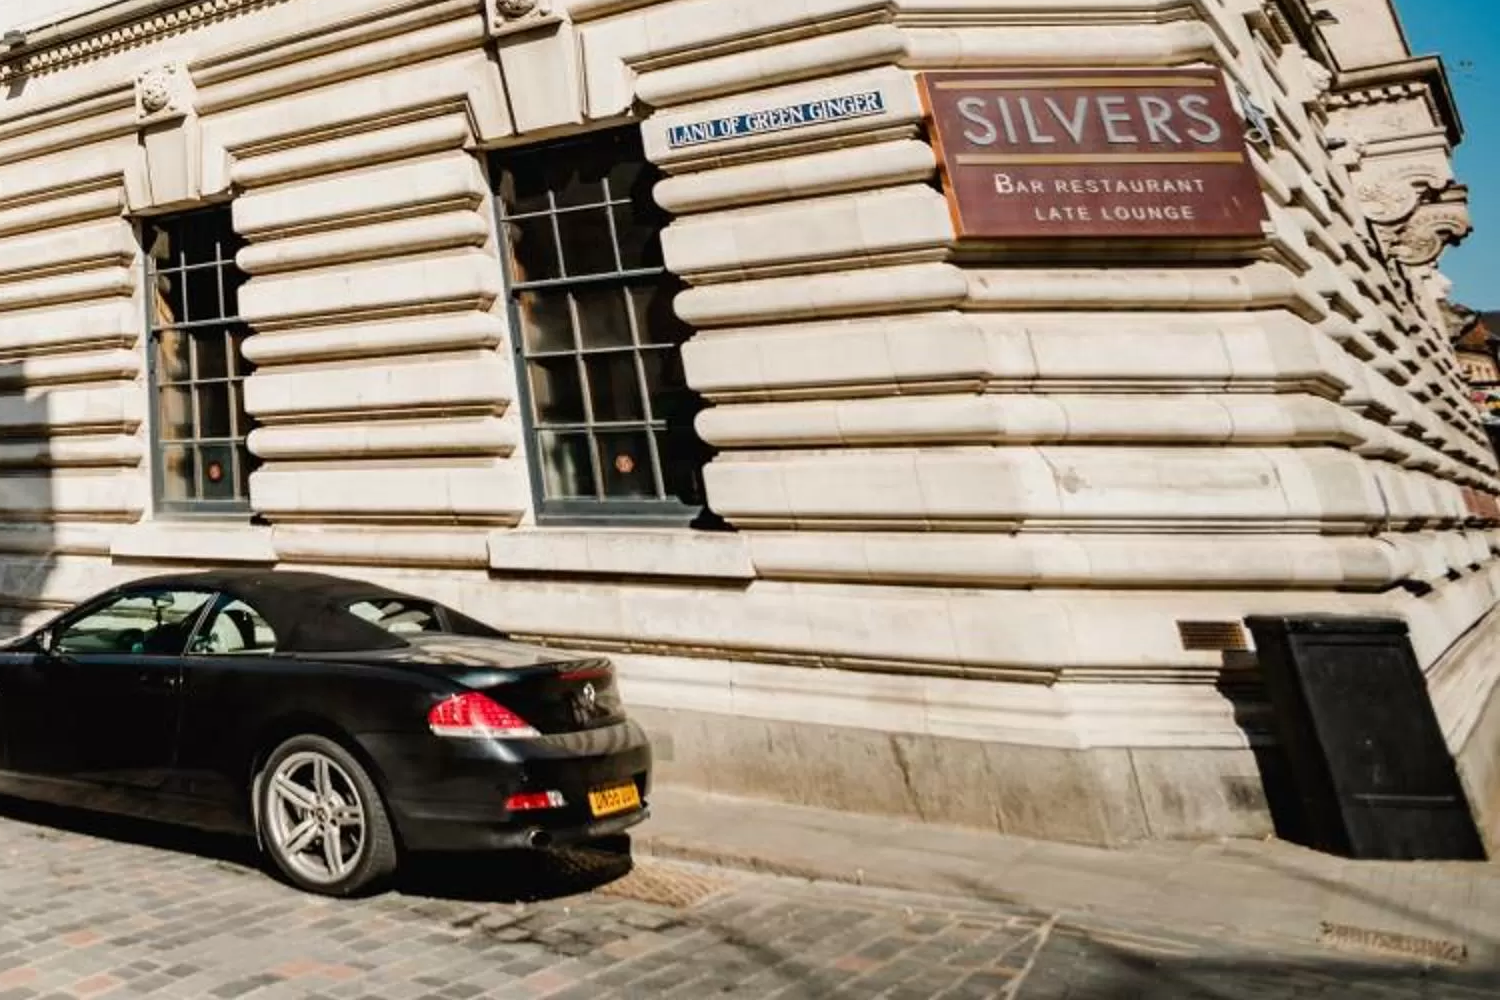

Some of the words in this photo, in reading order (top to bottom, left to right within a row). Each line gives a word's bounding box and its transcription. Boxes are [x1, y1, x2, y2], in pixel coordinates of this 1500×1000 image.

[719, 118, 741, 136] OF
[746, 108, 804, 131] GREEN
[809, 92, 880, 120] GINGER
[956, 94, 1221, 144] SILVERS
[1055, 178, 1205, 193] RESTAURANT
[1035, 206, 1092, 221] LATE
[1101, 205, 1196, 221] LOUNGE
